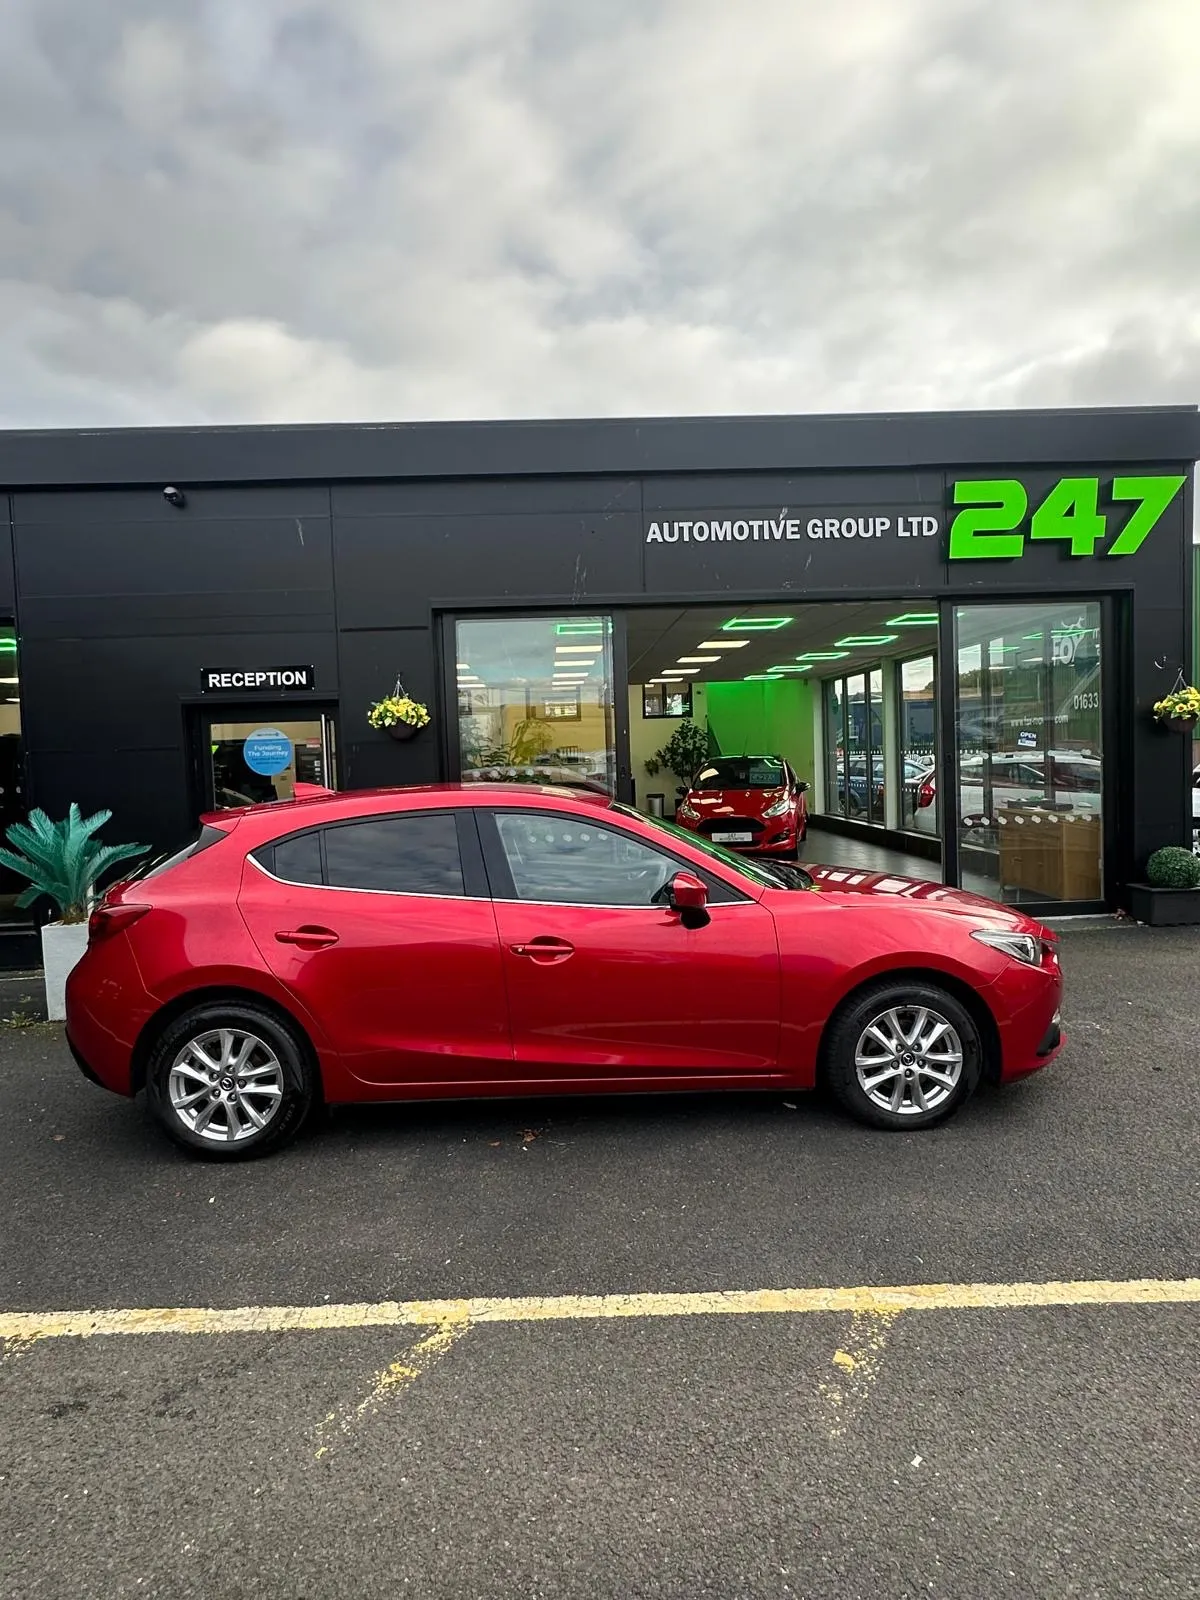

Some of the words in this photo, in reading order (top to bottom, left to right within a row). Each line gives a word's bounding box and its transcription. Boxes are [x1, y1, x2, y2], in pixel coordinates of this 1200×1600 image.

[949, 475, 1188, 559] 247
[646, 519, 800, 543] AUTOMOTIVE
[806, 517, 890, 539] GROUP
[897, 516, 939, 537] LTD
[208, 671, 307, 688] RECEPTION
[1073, 692, 1099, 709] 01633
[1020, 731, 1037, 739] OPEN
